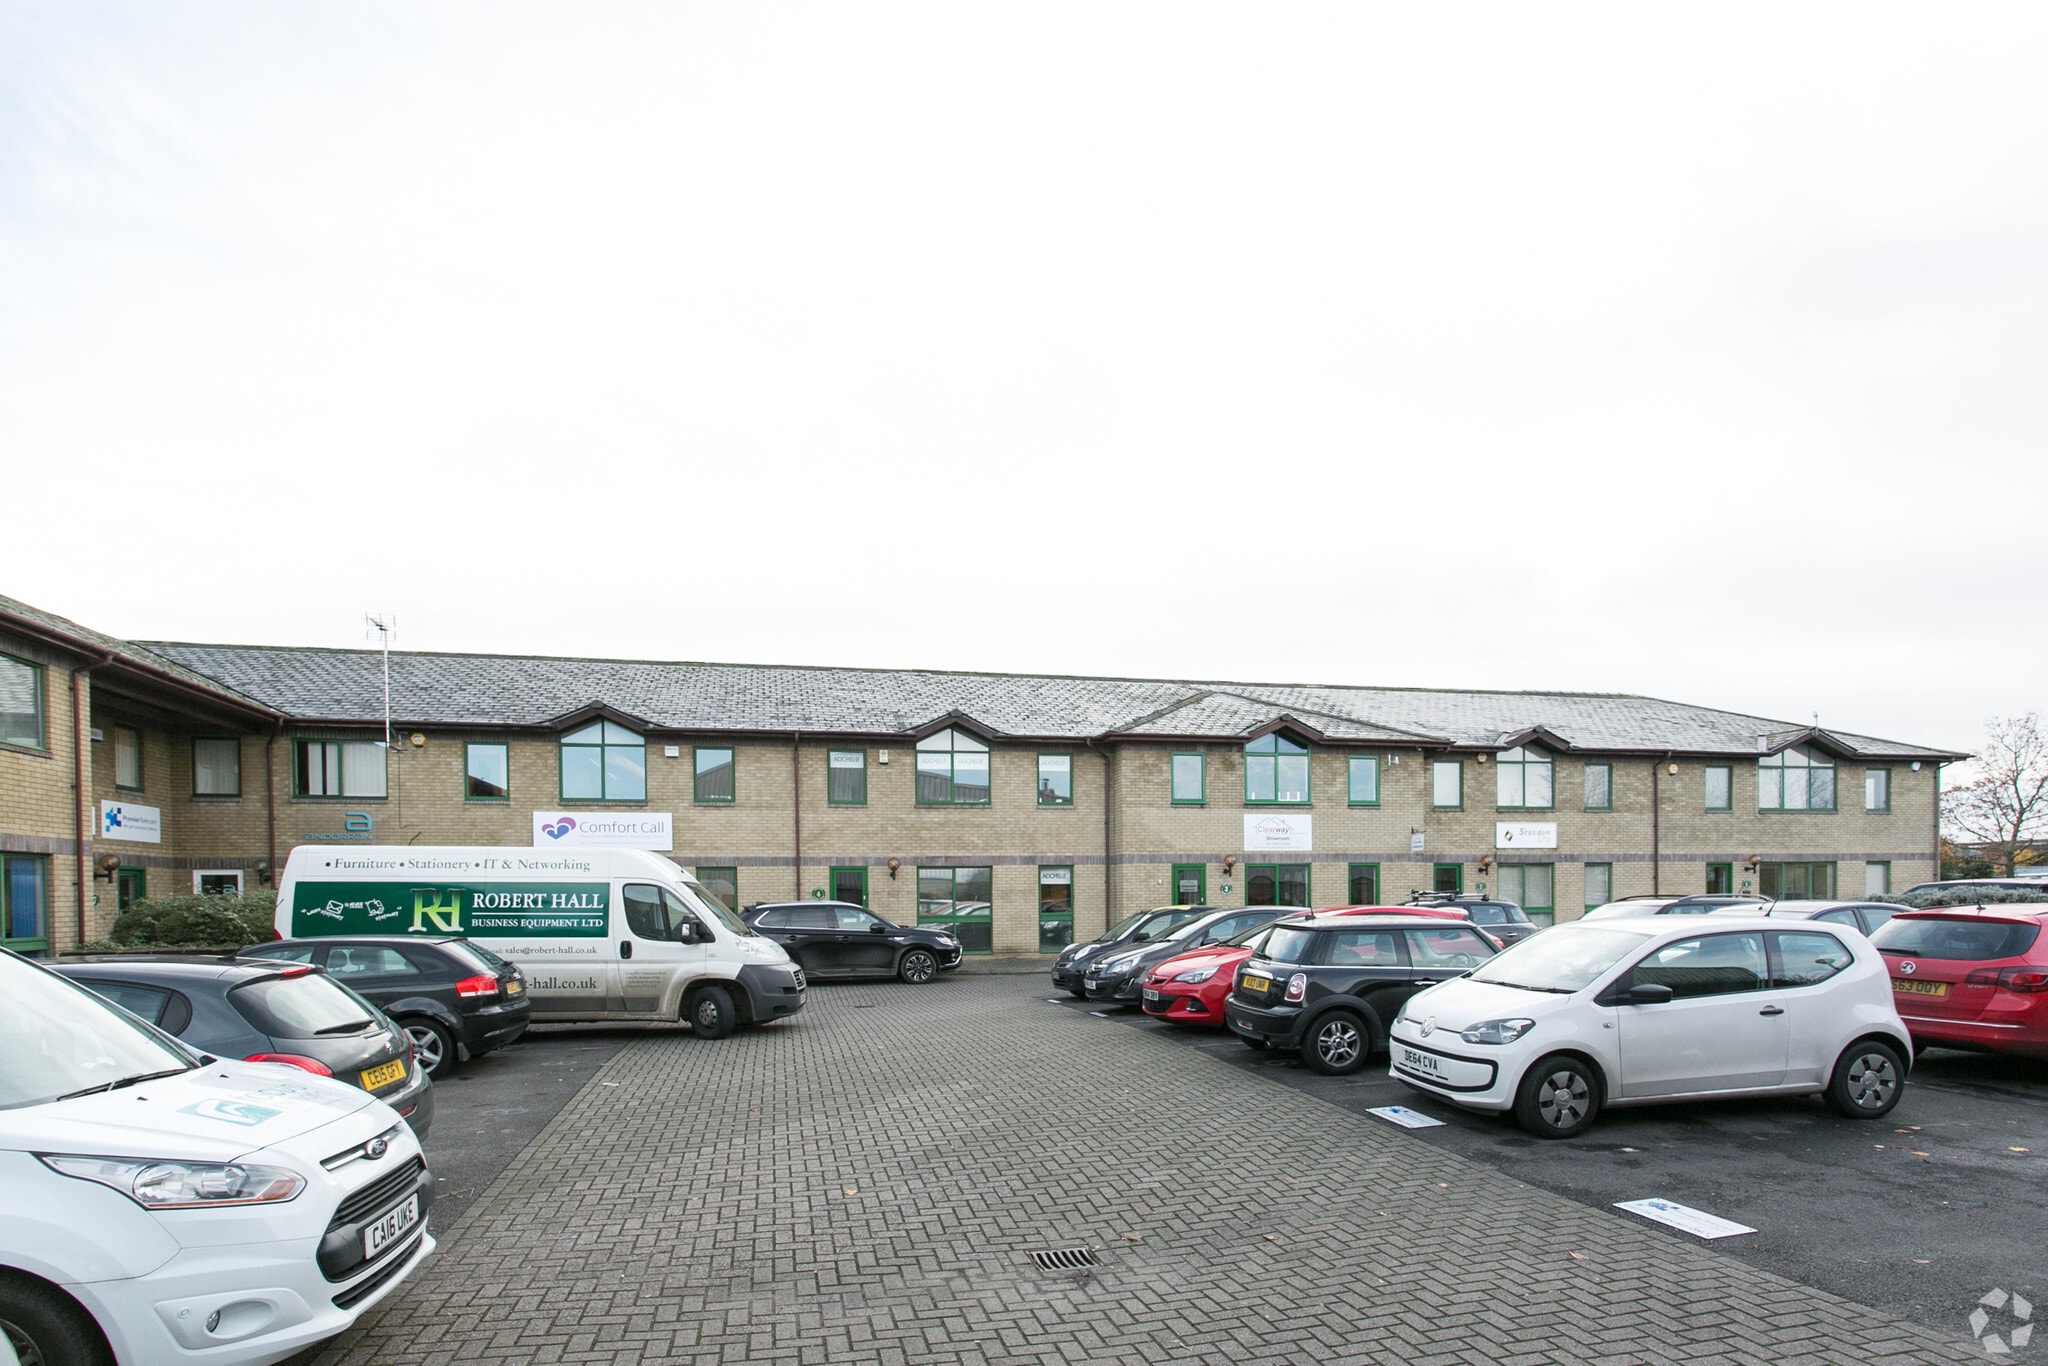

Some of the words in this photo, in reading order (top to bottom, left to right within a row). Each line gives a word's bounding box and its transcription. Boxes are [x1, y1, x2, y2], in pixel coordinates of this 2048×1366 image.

[579, 821, 637, 834] Comfort
[641, 821, 665, 834] Call
[1257, 826, 1290, 834] Clearway
[334, 858, 397, 869] Furniture
[408, 858, 472, 872] Stationery
[483, 859, 498, 869] IT
[502, 859, 512, 869] &
[518, 858, 591, 872] Networking
[471, 893, 547, 909] ROBERT
[550, 893, 604, 909] HALL
[407, 887, 465, 933] RH
[471, 918, 519, 928] BUSINESS
[520, 918, 578, 929] EQUIPMENT
[581, 918, 603, 928] LTD
[505, 946, 598, 955] sales@robert-hall.co.uk
[1892, 979, 1914, 991] S63
[1404, 1049, 1422, 1066] DE64
[1422, 1056, 1439, 1072] CVA
[367, 1067, 388, 1086] CE15
[386, 1062, 402, 1079] GFY
[372, 1215, 397, 1250] CA16
[396, 1201, 414, 1231] UKE
